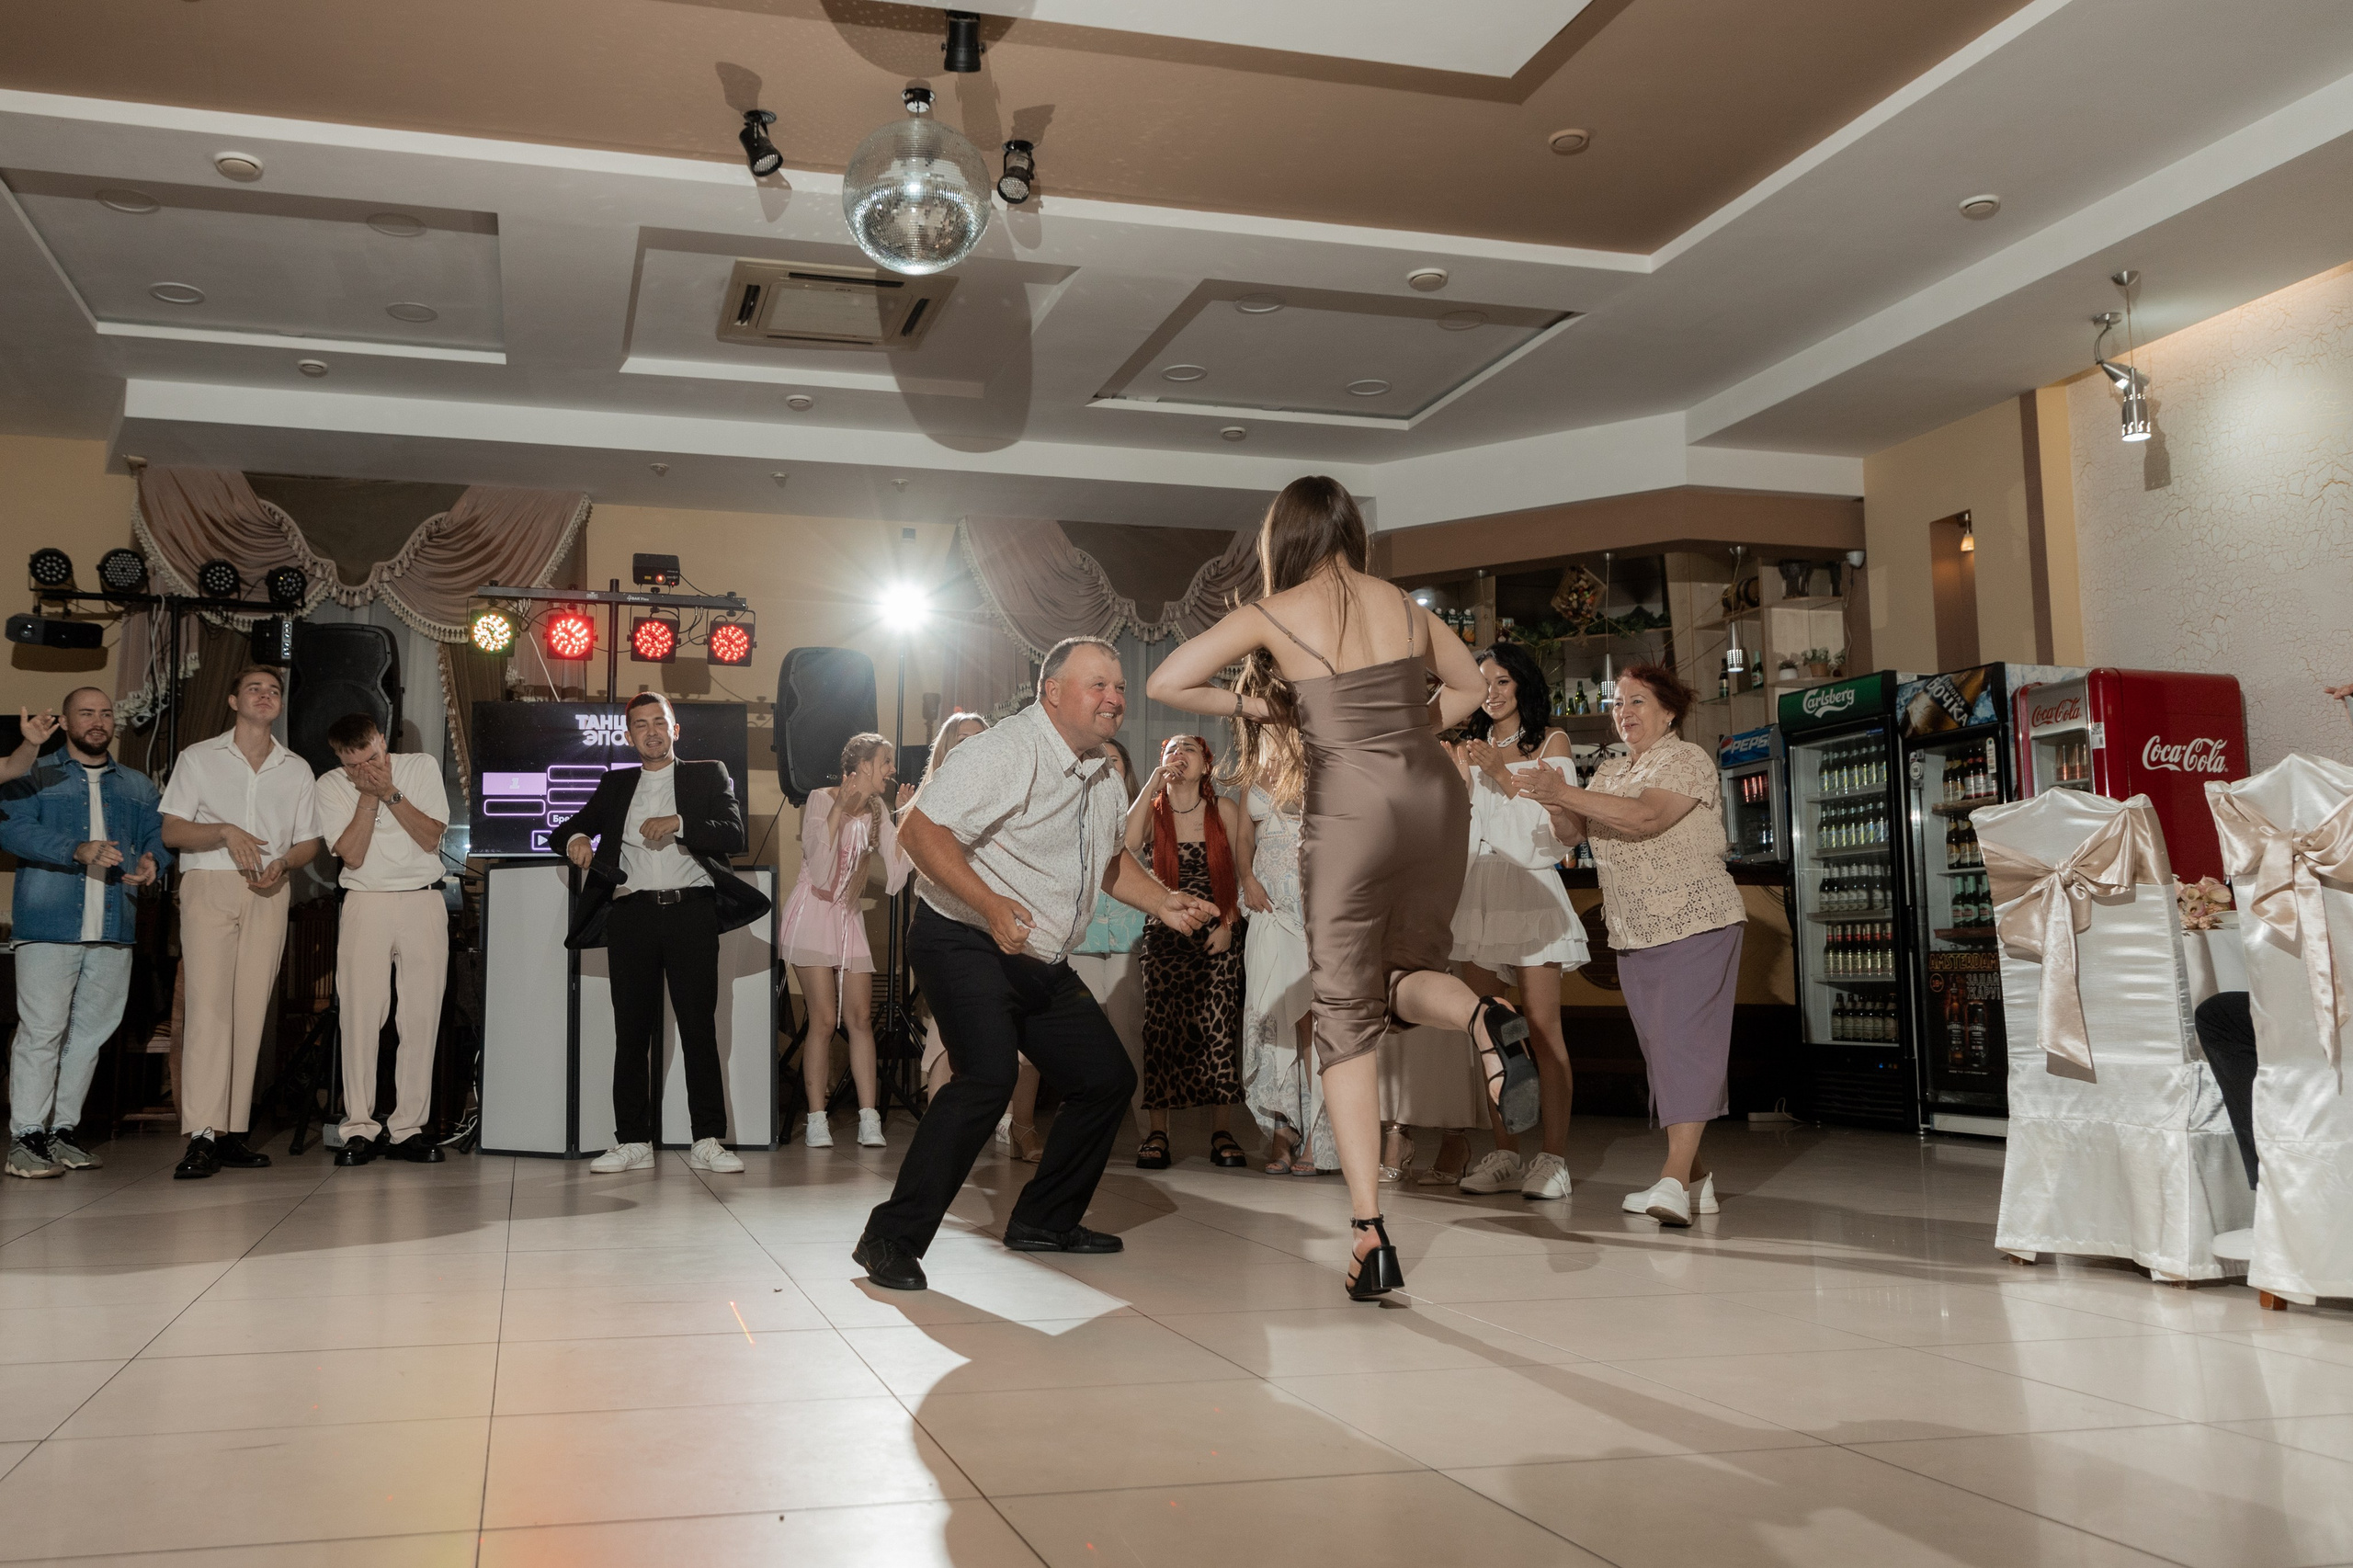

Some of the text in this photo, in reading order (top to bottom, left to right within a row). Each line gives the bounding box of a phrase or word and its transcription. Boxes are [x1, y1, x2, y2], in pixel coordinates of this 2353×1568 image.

[1802, 687, 1856, 719] Carlsberg
[1926, 676, 1968, 727] БОЧКА
[2031, 697, 2081, 728] Coca-Cola
[575, 714, 629, 732] ТАНЦ
[582, 730, 630, 746] ЭПО
[2142, 735, 2227, 773] Coca-Cola
[509, 778, 520, 790] 1
[552, 814, 573, 824] Бре
[1929, 952, 2000, 970] AMSTERDAM
